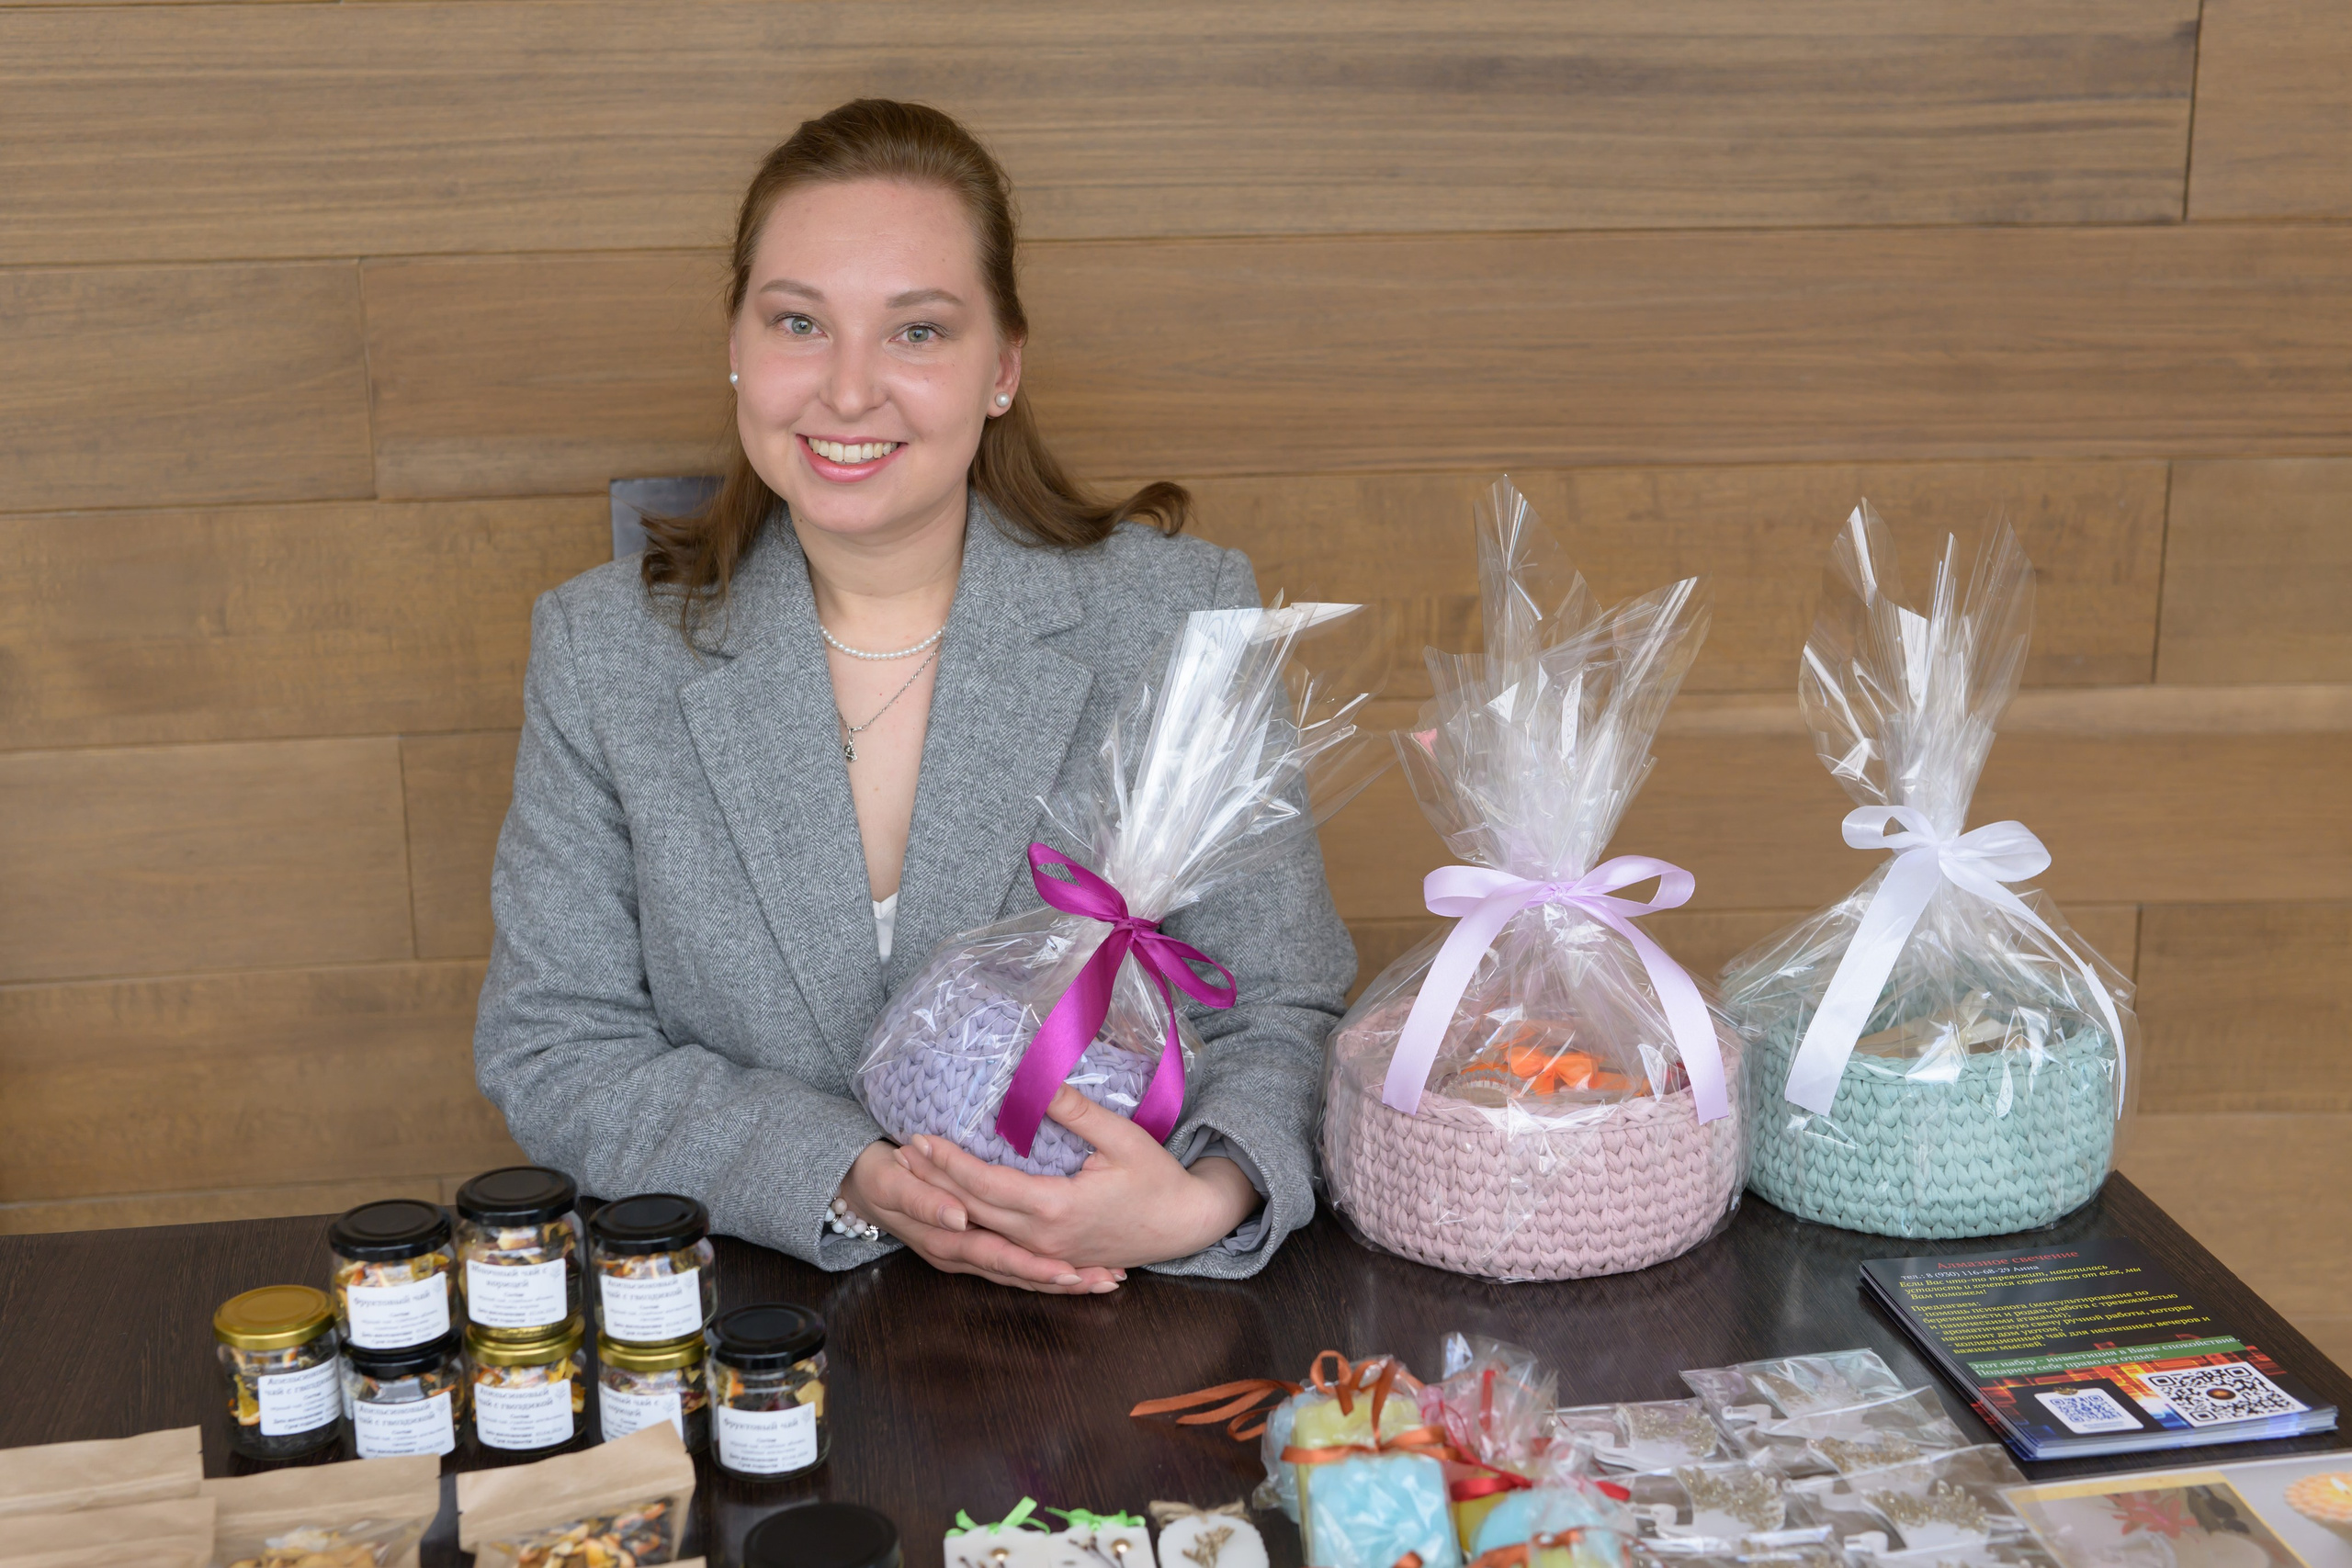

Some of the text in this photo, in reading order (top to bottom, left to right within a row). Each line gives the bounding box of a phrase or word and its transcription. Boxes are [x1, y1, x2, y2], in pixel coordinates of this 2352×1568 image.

[1938, 1251, 2080, 1269] Алмазное свечение
[522, 1268, 540, 1276] чай
[1962, 1267, 2010, 1276] 116-68-29
[1989, 1272, 2048, 1282] тревожит,
[2049, 1265, 2109, 1276] накопилась
[1905, 1285, 1962, 1295] усталость
[1973, 1280, 2015, 1289] хочется
[2016, 1274, 2079, 1286] спрятаться
[413, 1289, 430, 1300] чай
[1935, 1290, 1987, 1299] поможем!
[1911, 1302, 1982, 1313] Предлагаем:
[1922, 1312, 2002, 1324] беременности
[2013, 1307, 2052, 1317] родам,
[2052, 1303, 2089, 1313] работа
[2099, 1293, 2178, 1307] тревожностью
[1925, 1309, 1970, 1317] помощь
[1971, 1303, 2028, 1314] психолога
[2029, 1291, 2132, 1309] (консультирование
[1939, 1318, 2014, 1329] паническими
[2017, 1312, 2072, 1323] атаками);
[1942, 1322, 2030, 1336] ароматическую
[2030, 1318, 2061, 1327] свечу
[2063, 1314, 2104, 1325] ручной
[2104, 1310, 2150, 1320] работы,
[2150, 1304, 2194, 1314] которая
[1940, 1332, 1995, 1342] наполнит
[2020, 1326, 2064, 1337] уютом;
[1954, 1333, 2045, 1348] коллекционный
[2046, 1331, 2067, 1339] чай
[2090, 1322, 2155, 1335] неспешных
[2155, 1317, 2200, 1327] вечеров
[1952, 1340, 2047, 1355] важных мыслей.
[2000, 1359, 2037, 1368] набор
[2045, 1350, 2118, 1363] инвестиция
[2128, 1346, 2161, 1355] Ваше
[2162, 1337, 2241, 1351] спокойствие.
[1976, 1352, 2161, 1377] Подарите себе право на отдых.
[265, 1387, 284, 1395] чай
[780, 1418, 798, 1428] чай
